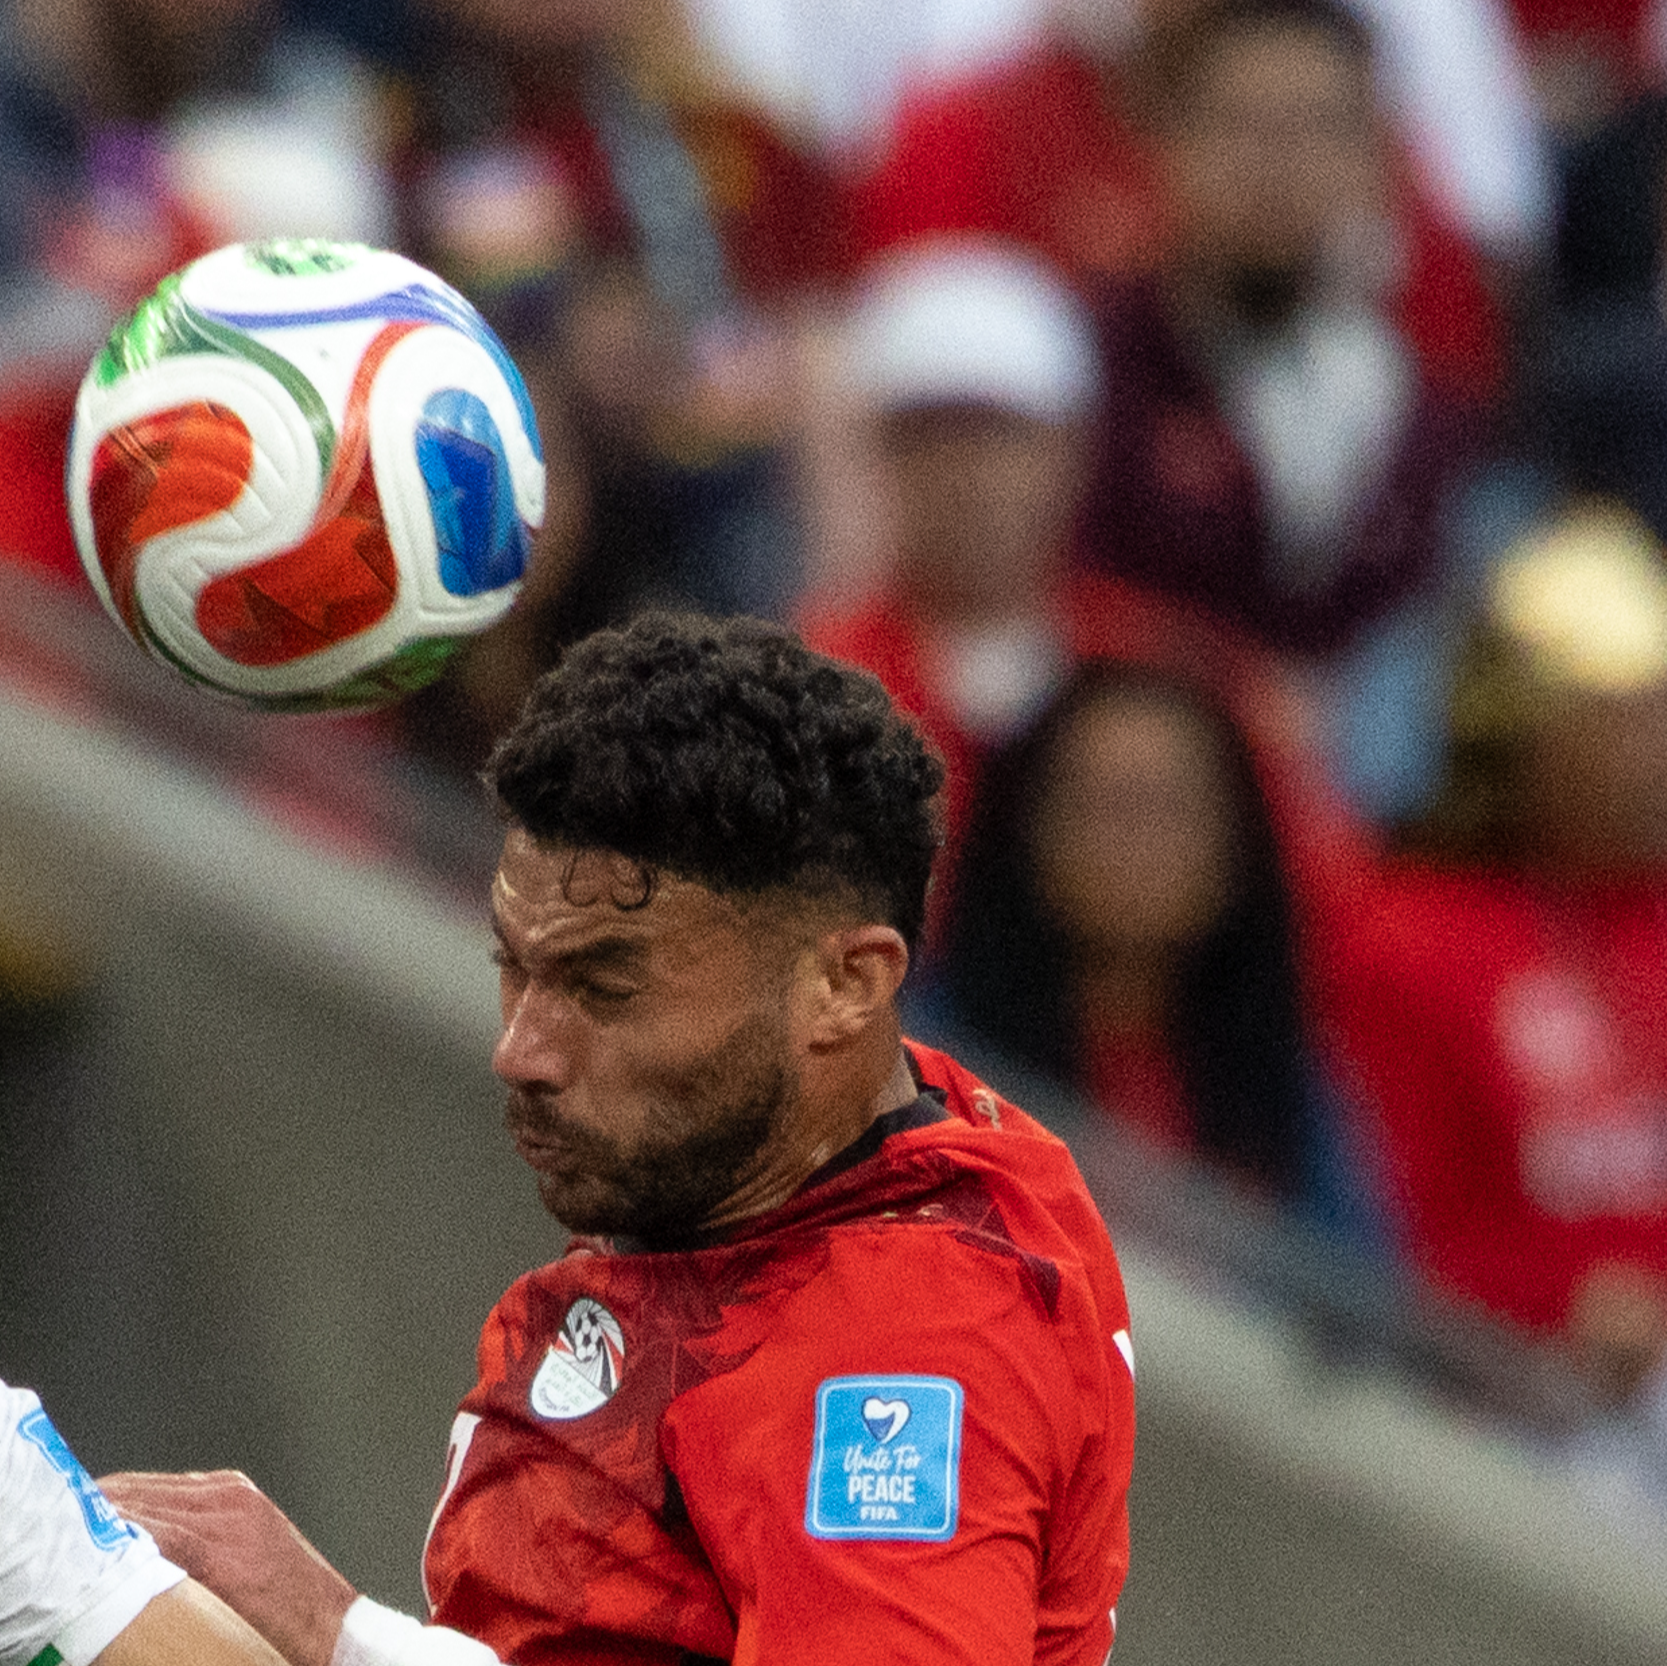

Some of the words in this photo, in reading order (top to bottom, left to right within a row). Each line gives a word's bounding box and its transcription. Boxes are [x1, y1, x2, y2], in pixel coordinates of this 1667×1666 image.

[843, 1443, 893, 1474] Unite
[894, 1444, 921, 1472] For
[848, 1475, 916, 1504] PEACE
[860, 1505, 899, 1521] FIFA
